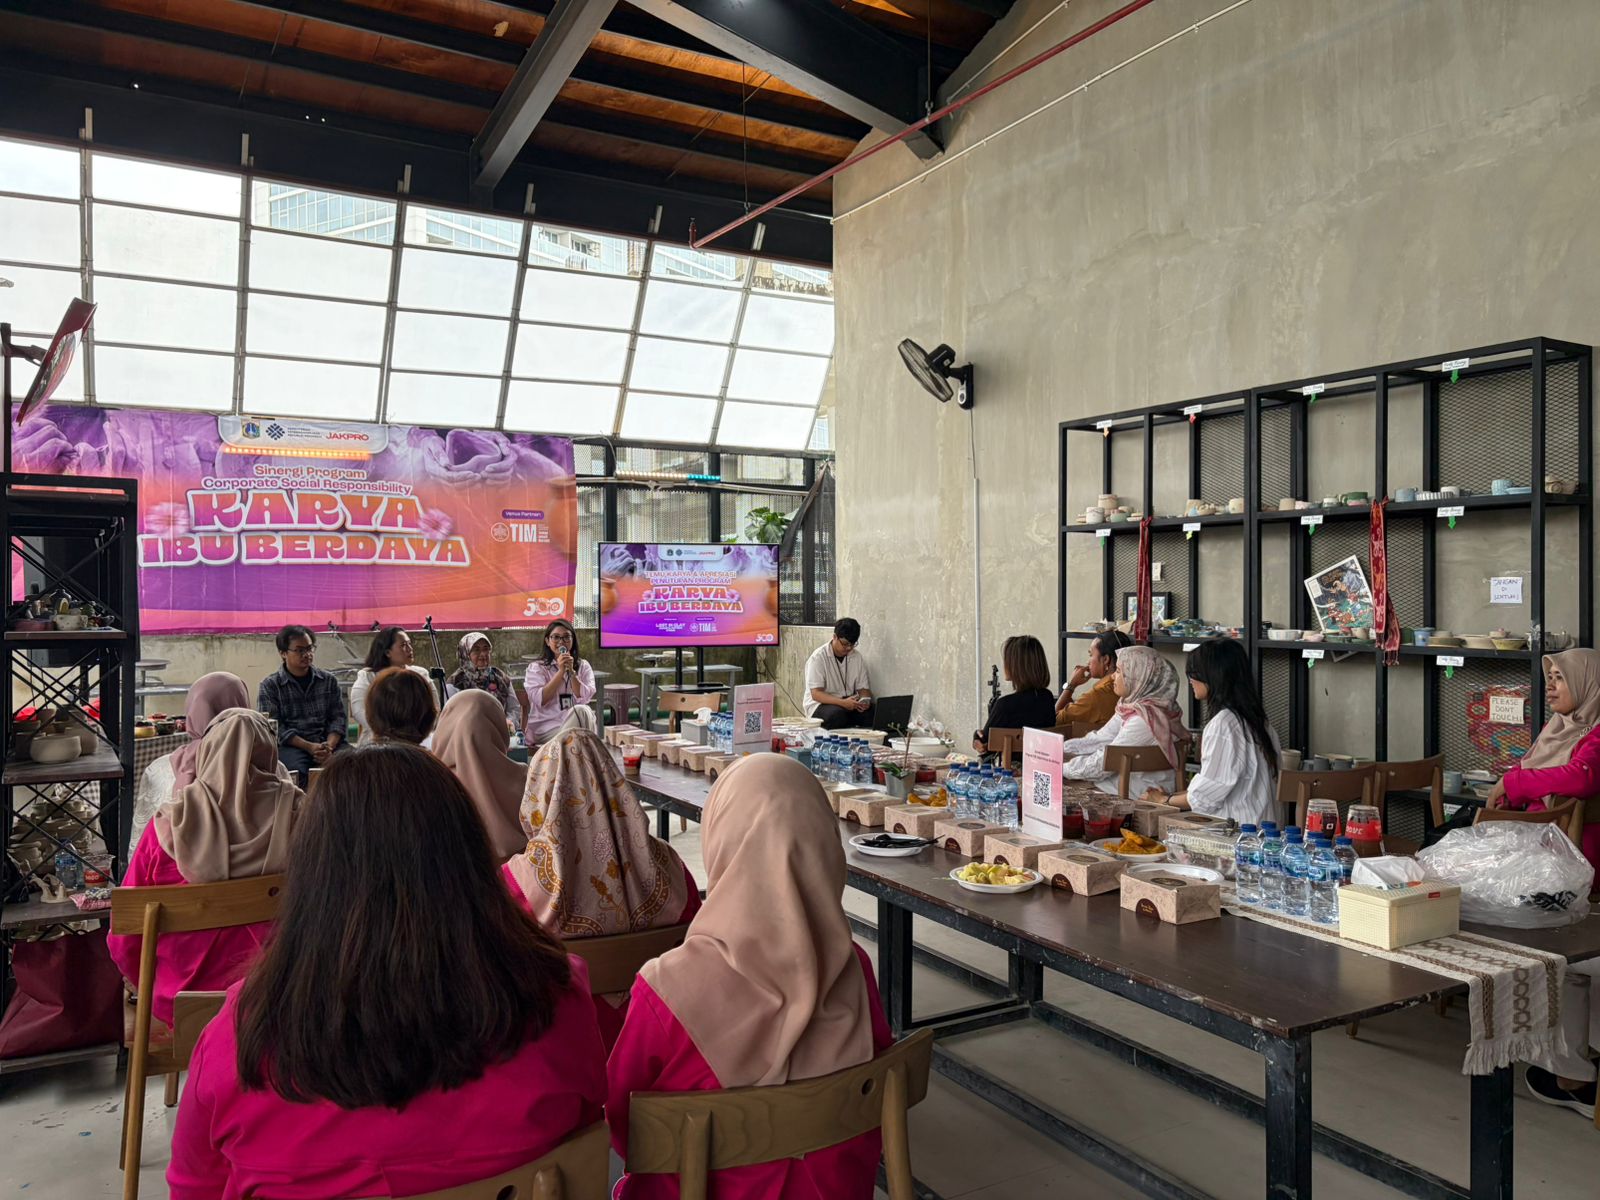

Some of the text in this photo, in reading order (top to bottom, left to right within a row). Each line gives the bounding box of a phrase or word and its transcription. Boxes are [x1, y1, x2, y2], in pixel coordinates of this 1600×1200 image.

[326, 432, 369, 441] JAKPRO
[254, 465, 366, 480] Sinergi Program
[203, 478, 413, 496] Corporate Social Responsibility
[188, 490, 425, 532] KARYA
[510, 523, 537, 543] TIM
[137, 532, 470, 567] IBU BERDAYA
[653, 586, 728, 601] KARYA
[638, 601, 743, 613] IBU BERDAYA
[1492, 698, 1519, 706] PLEASE
